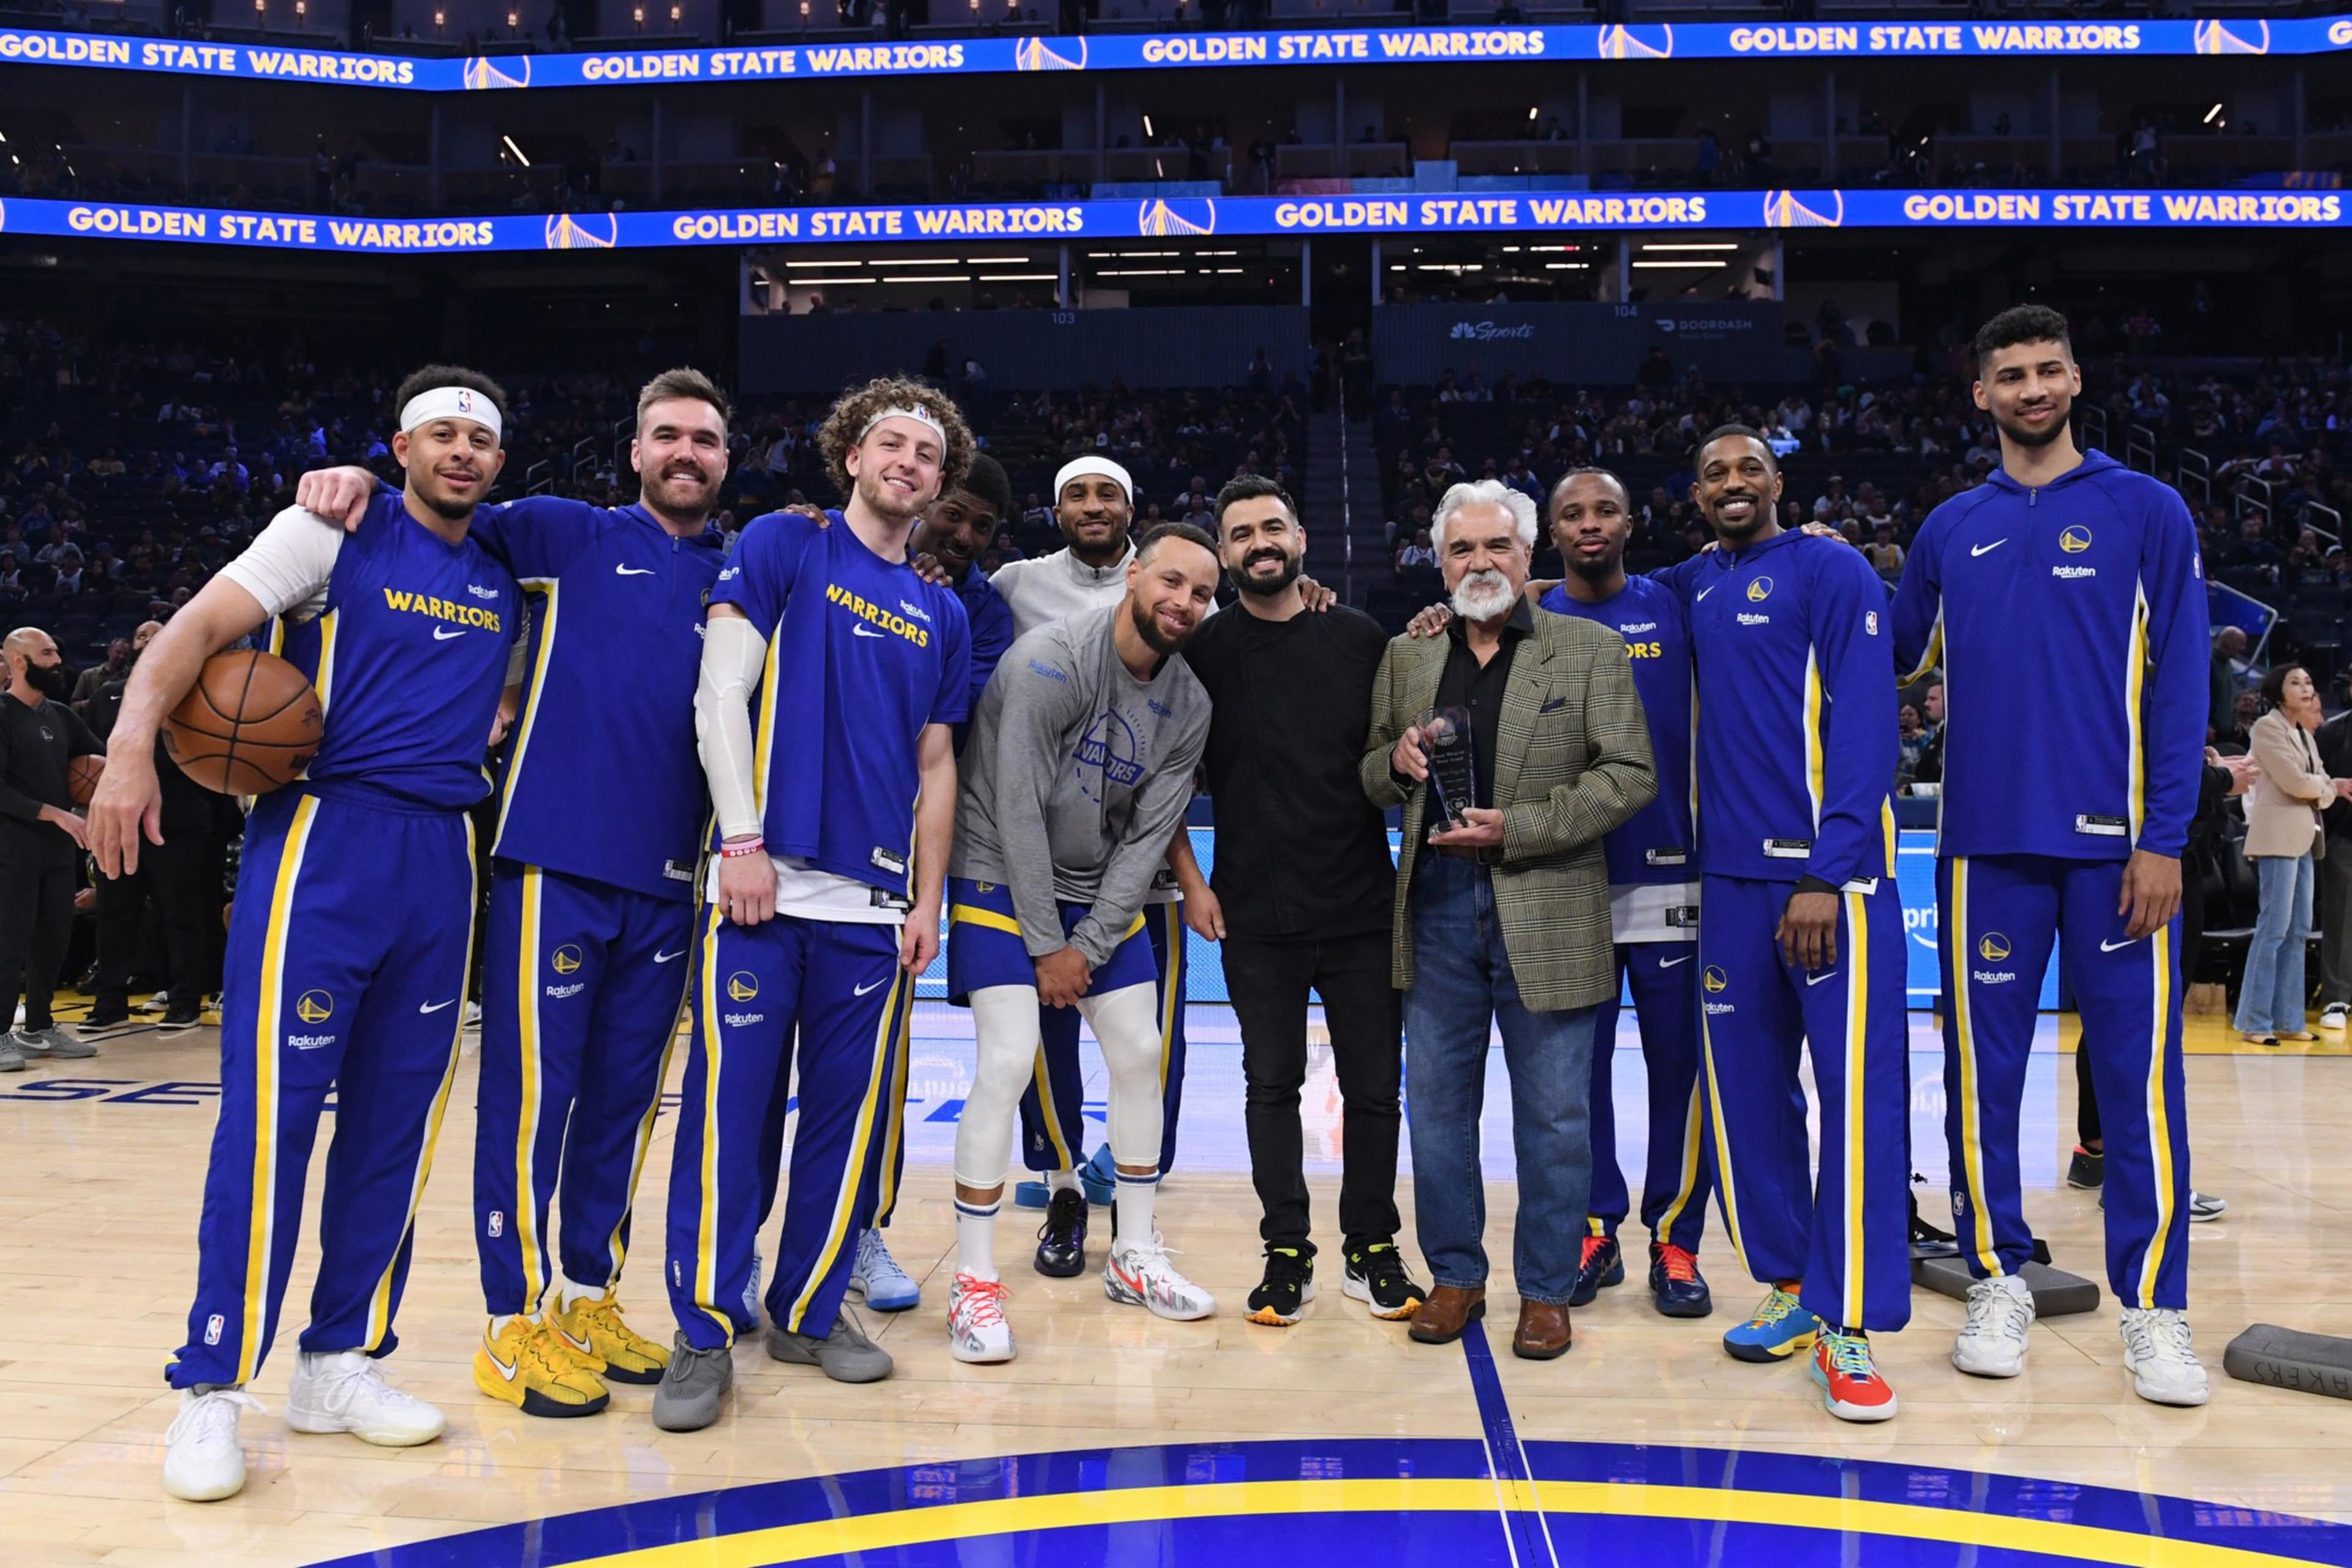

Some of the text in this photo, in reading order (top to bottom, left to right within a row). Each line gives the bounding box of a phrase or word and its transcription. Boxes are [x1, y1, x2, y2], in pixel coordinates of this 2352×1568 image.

[1142, 30, 1545, 62] GOLDEN STATE WARRIORS
[1730, 25, 2141, 51] GOLDEN STATE WARRIORS
[0, 33, 413, 84] GOLDEN STATE WARRIORS
[582, 44, 964, 80] GOLDEN STATE WARRIORS
[1275, 197, 1706, 227] GOLDEN STATE WARRIORS
[1904, 195, 2341, 221] GOLDEN STATE WARRIORS
[68, 207, 493, 247] GOLDEN STATE WARRIORS
[673, 206, 1083, 239] GOLDEN STATE WARRIORS
[1052, 312, 1075, 324] 103
[1614, 305, 1638, 317] 104
[1476, 322, 1533, 342] Sports
[1679, 320, 1752, 330] DOORDASH
[2052, 566, 2096, 578] Rakuten
[383, 588, 500, 633] WARRIORS
[1736, 613, 1770, 625] Rakuten
[1620, 622, 1657, 633] Rakuten
[1902, 902, 1938, 932] pri
[1974, 970, 2015, 984] Rakuten
[547, 982, 584, 998] Rakuten
[1704, 1002, 1735, 1014] akuten
[725, 1013, 763, 1027] Rakuten
[288, 1035, 335, 1049] Rakuten
[2254, 1361, 2350, 1393] AKERS
